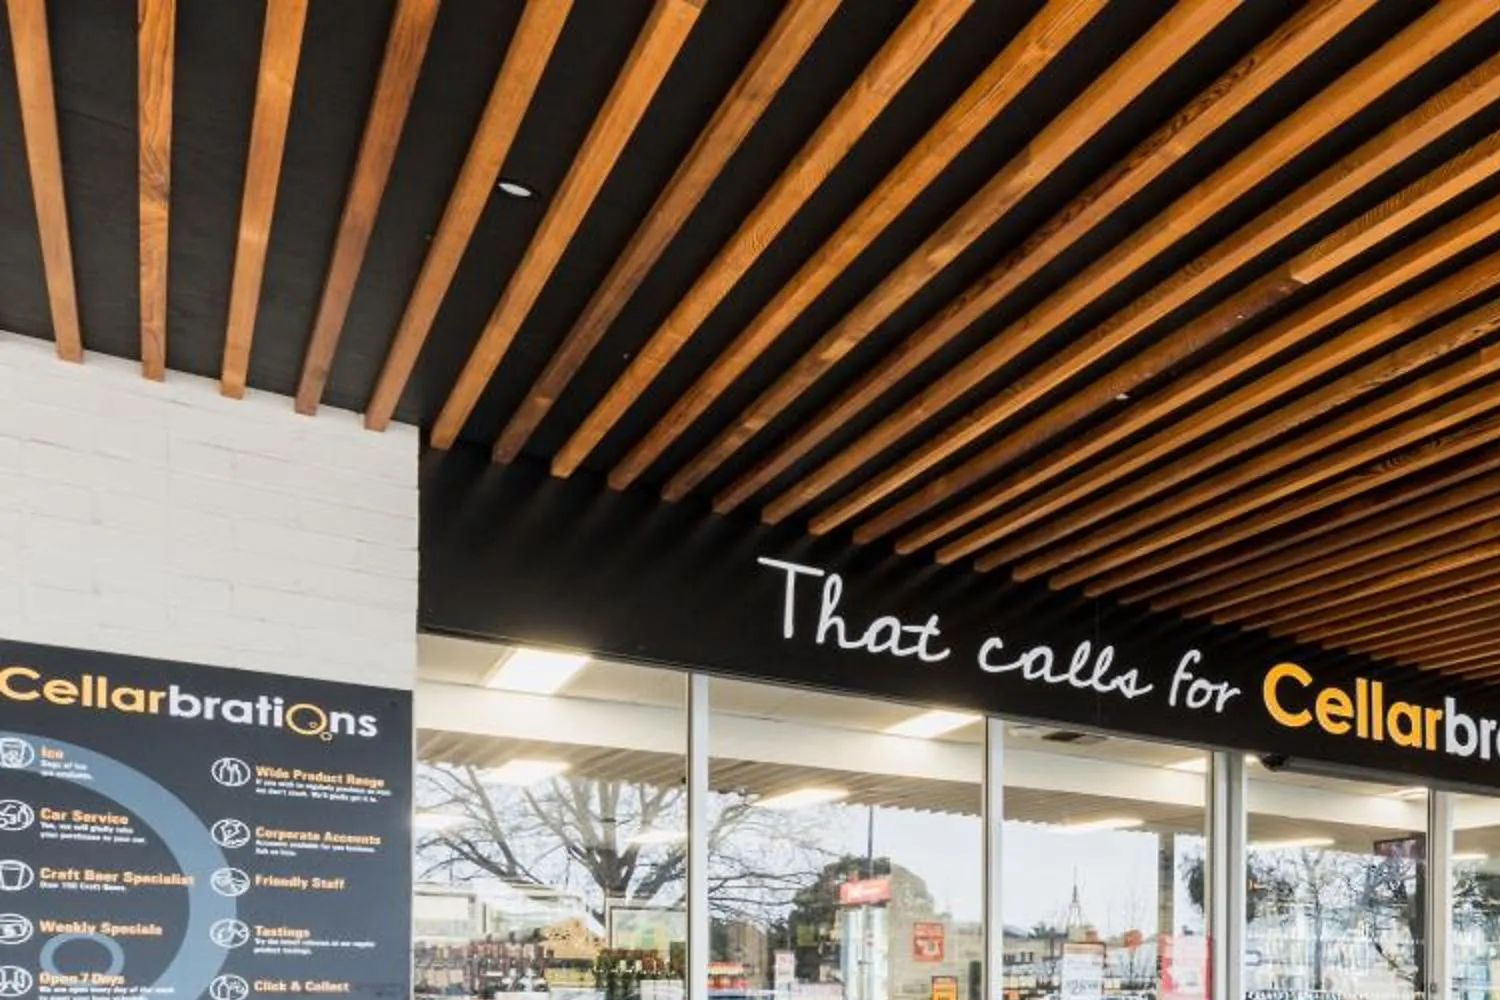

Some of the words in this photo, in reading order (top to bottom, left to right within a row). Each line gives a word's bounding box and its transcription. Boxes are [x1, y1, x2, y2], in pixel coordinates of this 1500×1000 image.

[757, 556, 951, 661] That
[977, 636, 1154, 698] calls
[1168, 649, 1241, 713] for
[256, 765, 290, 780] Wide
[293, 769, 343, 785] Product
[346, 773, 386, 789] Range
[40, 807, 68, 822] Car
[72, 809, 130, 825] Service
[256, 826, 321, 842] Corporate
[324, 831, 382, 846] Accounts
[40, 867, 80, 881] Craft
[84, 869, 119, 883] Beer
[123, 871, 196, 886] Specialist
[255, 874, 309, 891] Friendly
[311, 877, 345, 890] Staff
[39, 919, 97, 936] Weekly
[101, 921, 164, 937] Specials
[254, 926, 311, 940] Tastings
[39, 972, 78, 985] Open
[79, 972, 89, 984] 7
[92, 973, 125, 986] Days
[254, 980, 287, 993] Click
[305, 981, 351, 993] Collect
